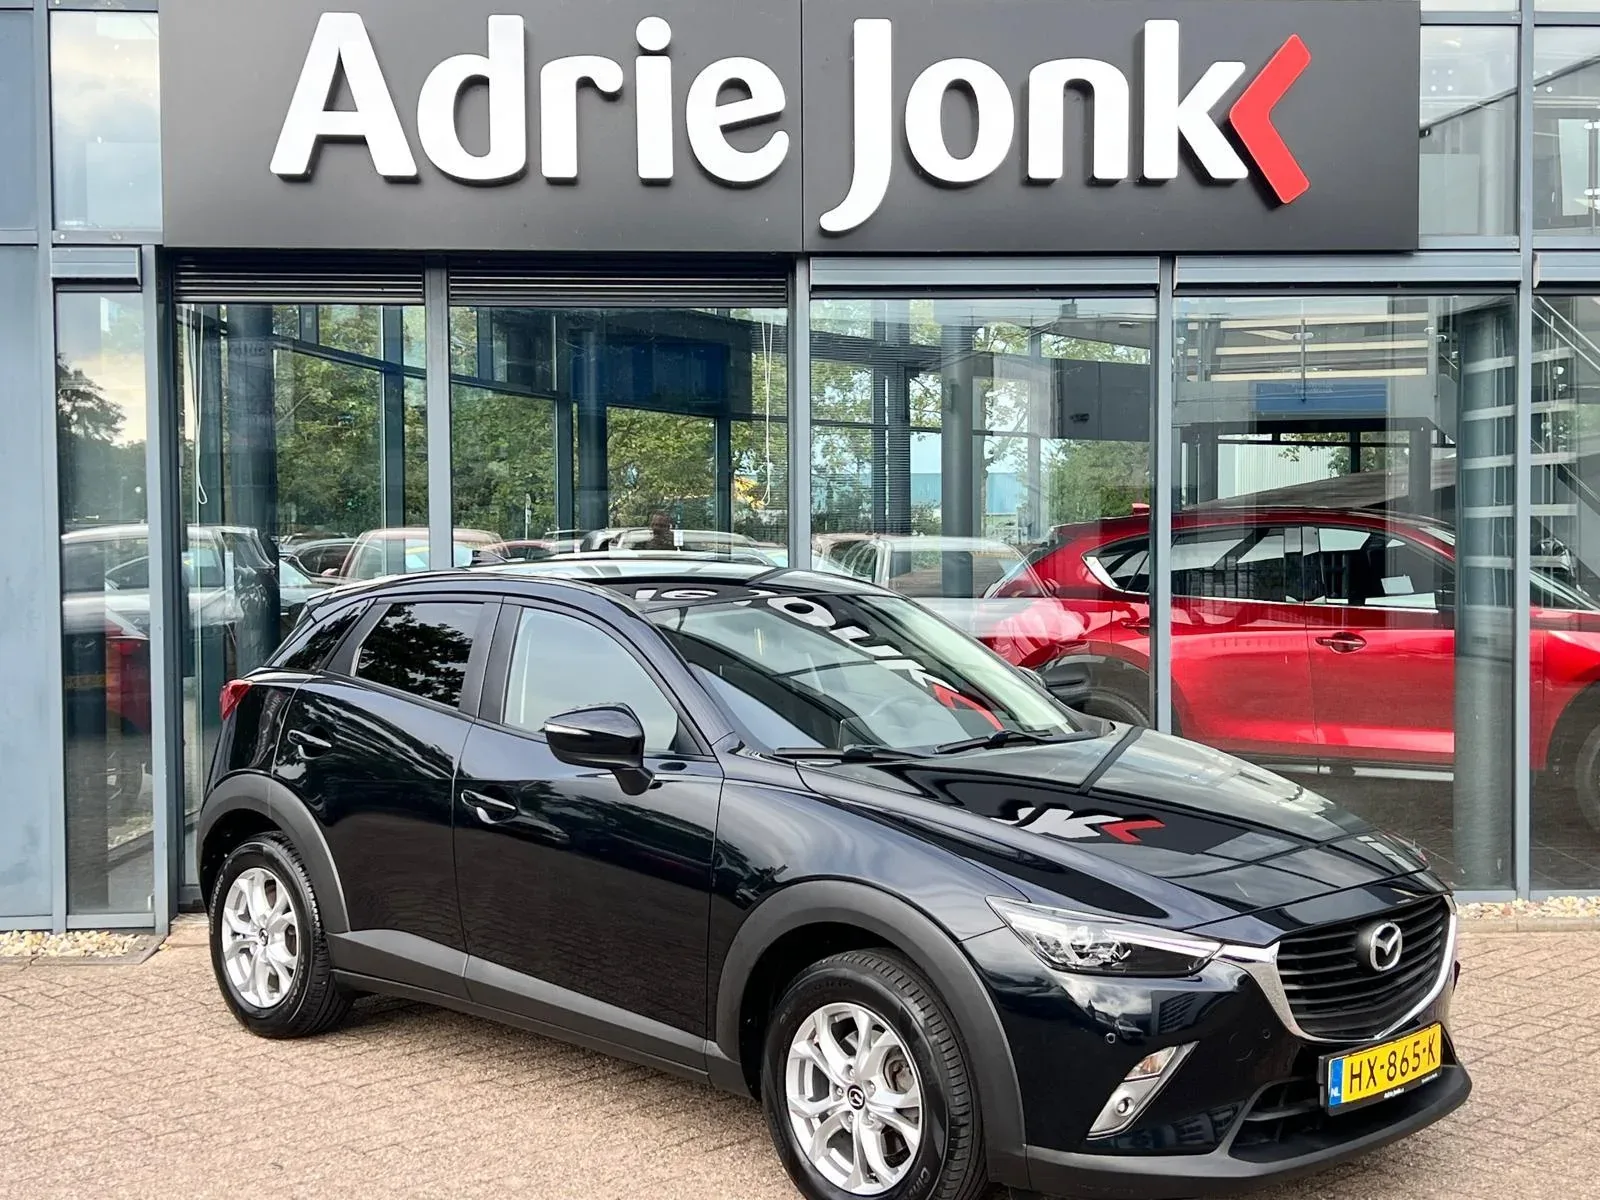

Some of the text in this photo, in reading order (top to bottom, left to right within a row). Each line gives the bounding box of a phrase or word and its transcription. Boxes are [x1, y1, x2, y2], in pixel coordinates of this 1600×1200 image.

[269, 11, 1249, 233] Adrie Jonk
[1330, 1087, 1341, 1098] NL
[1349, 1032, 1436, 1094] HX-865-K
